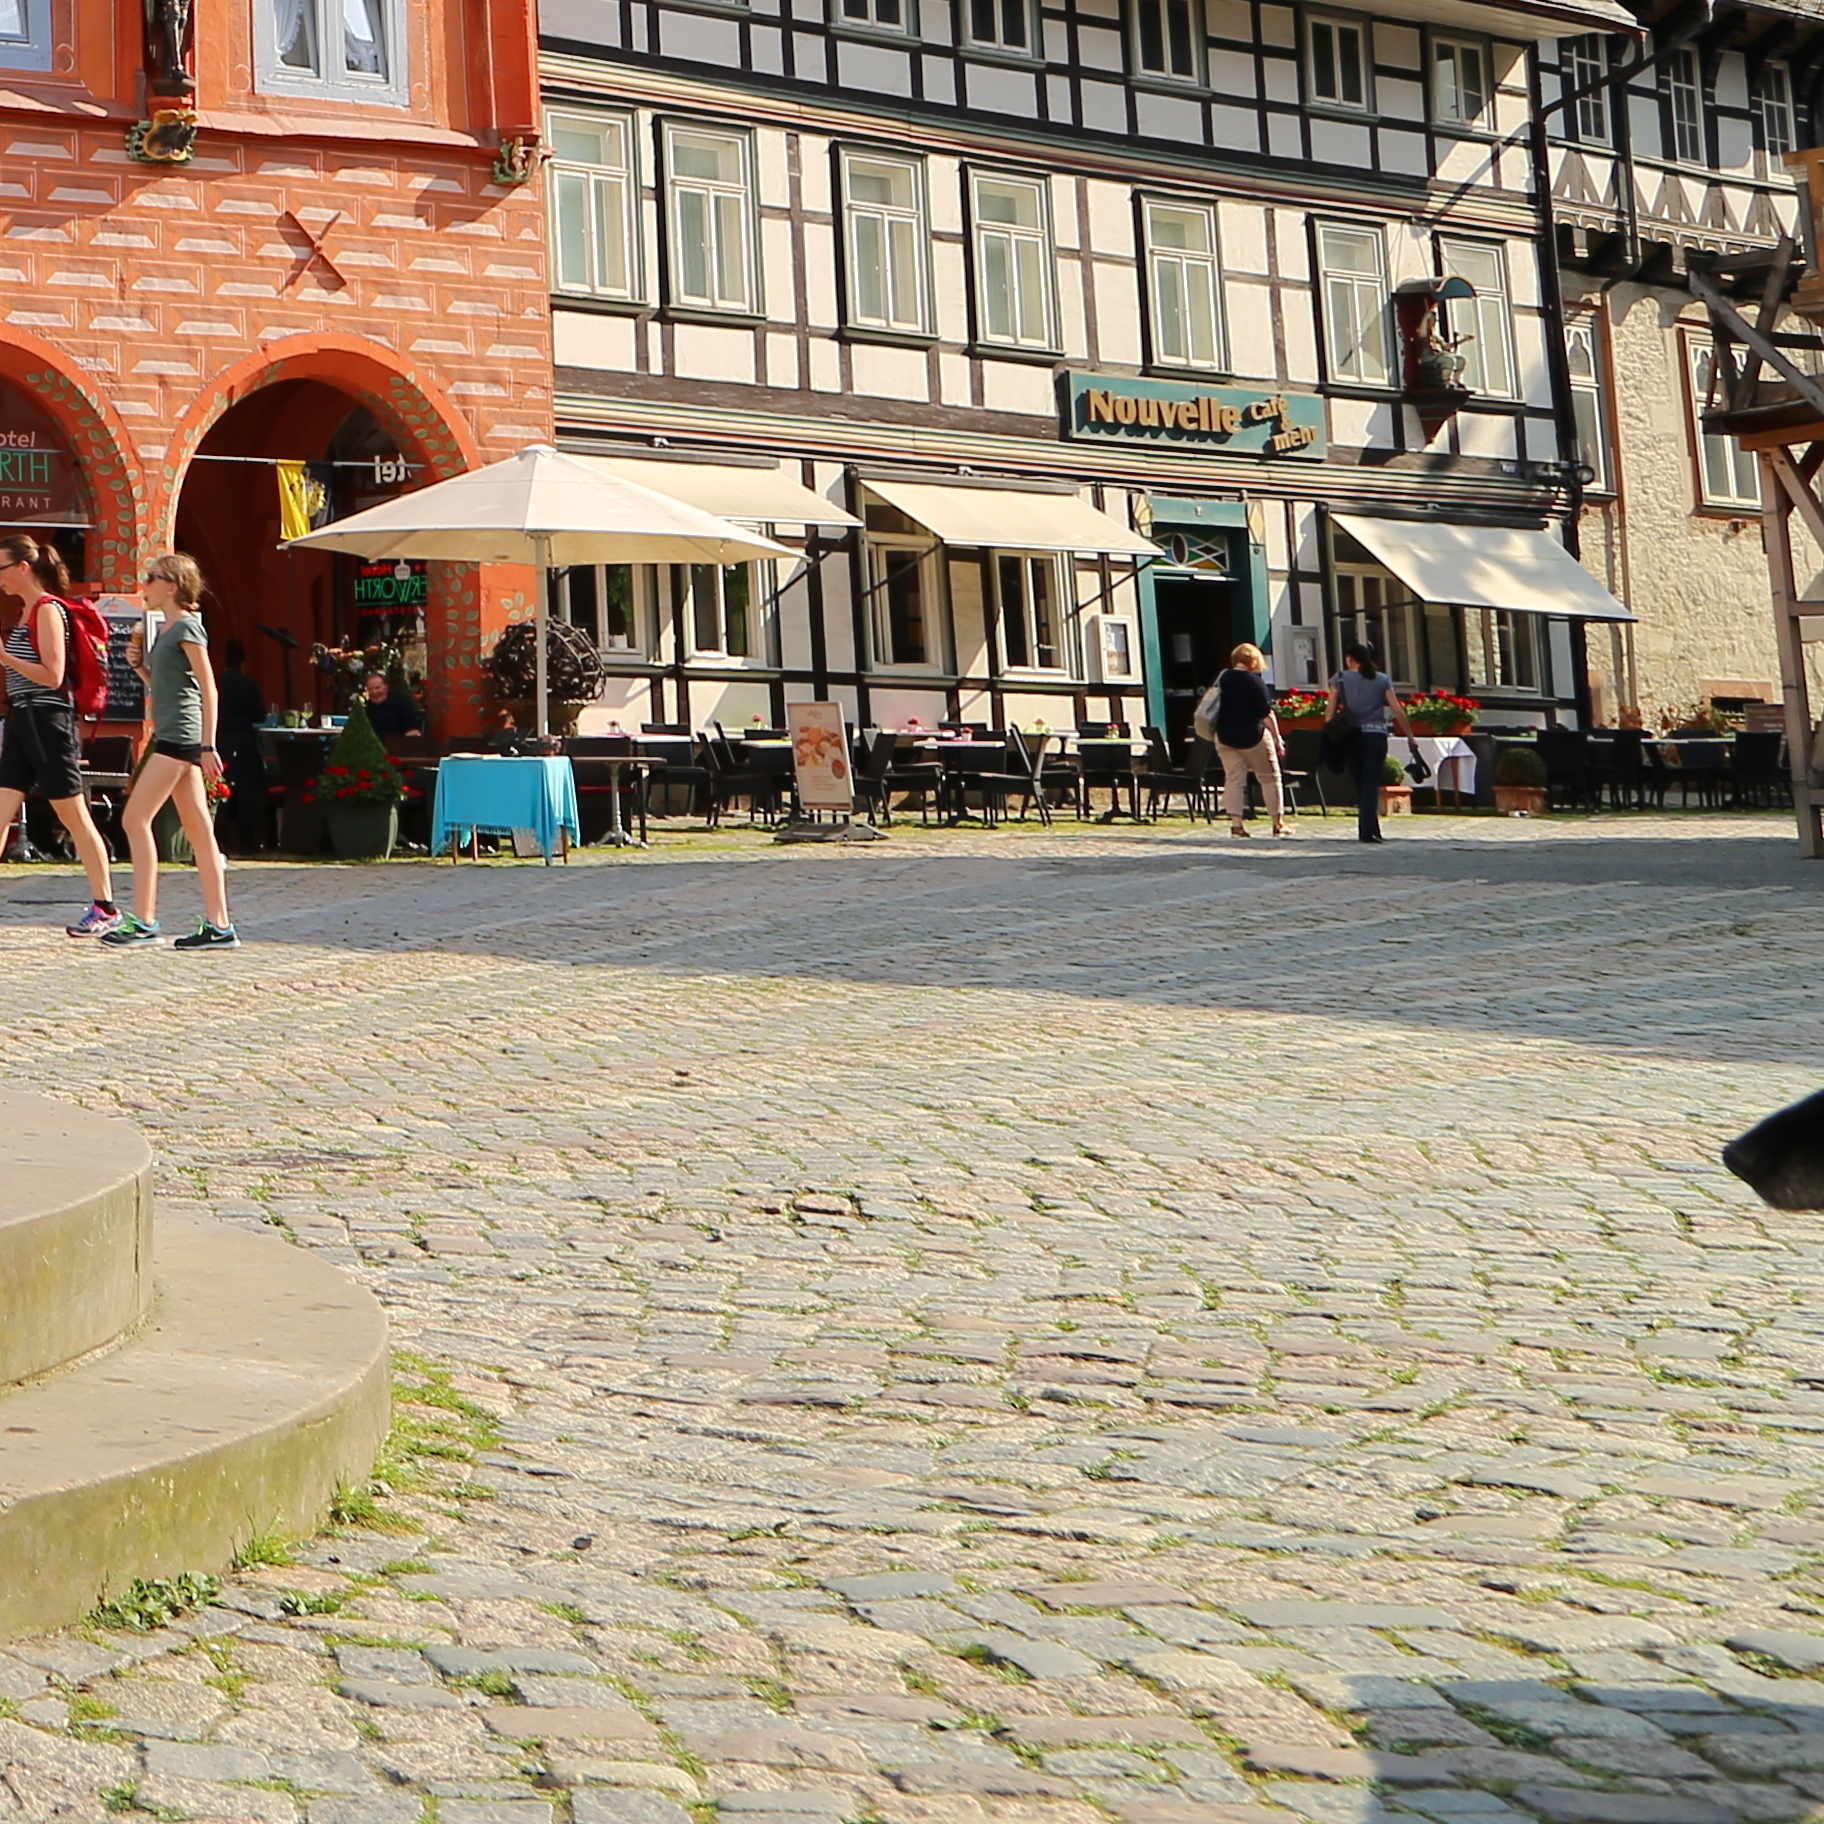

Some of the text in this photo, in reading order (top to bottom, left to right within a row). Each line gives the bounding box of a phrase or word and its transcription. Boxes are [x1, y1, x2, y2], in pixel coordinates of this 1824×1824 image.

[1086, 388, 1243, 434] Nouvelle
[1250, 392, 1289, 421] Café
[1271, 426, 1318, 452] mehr
